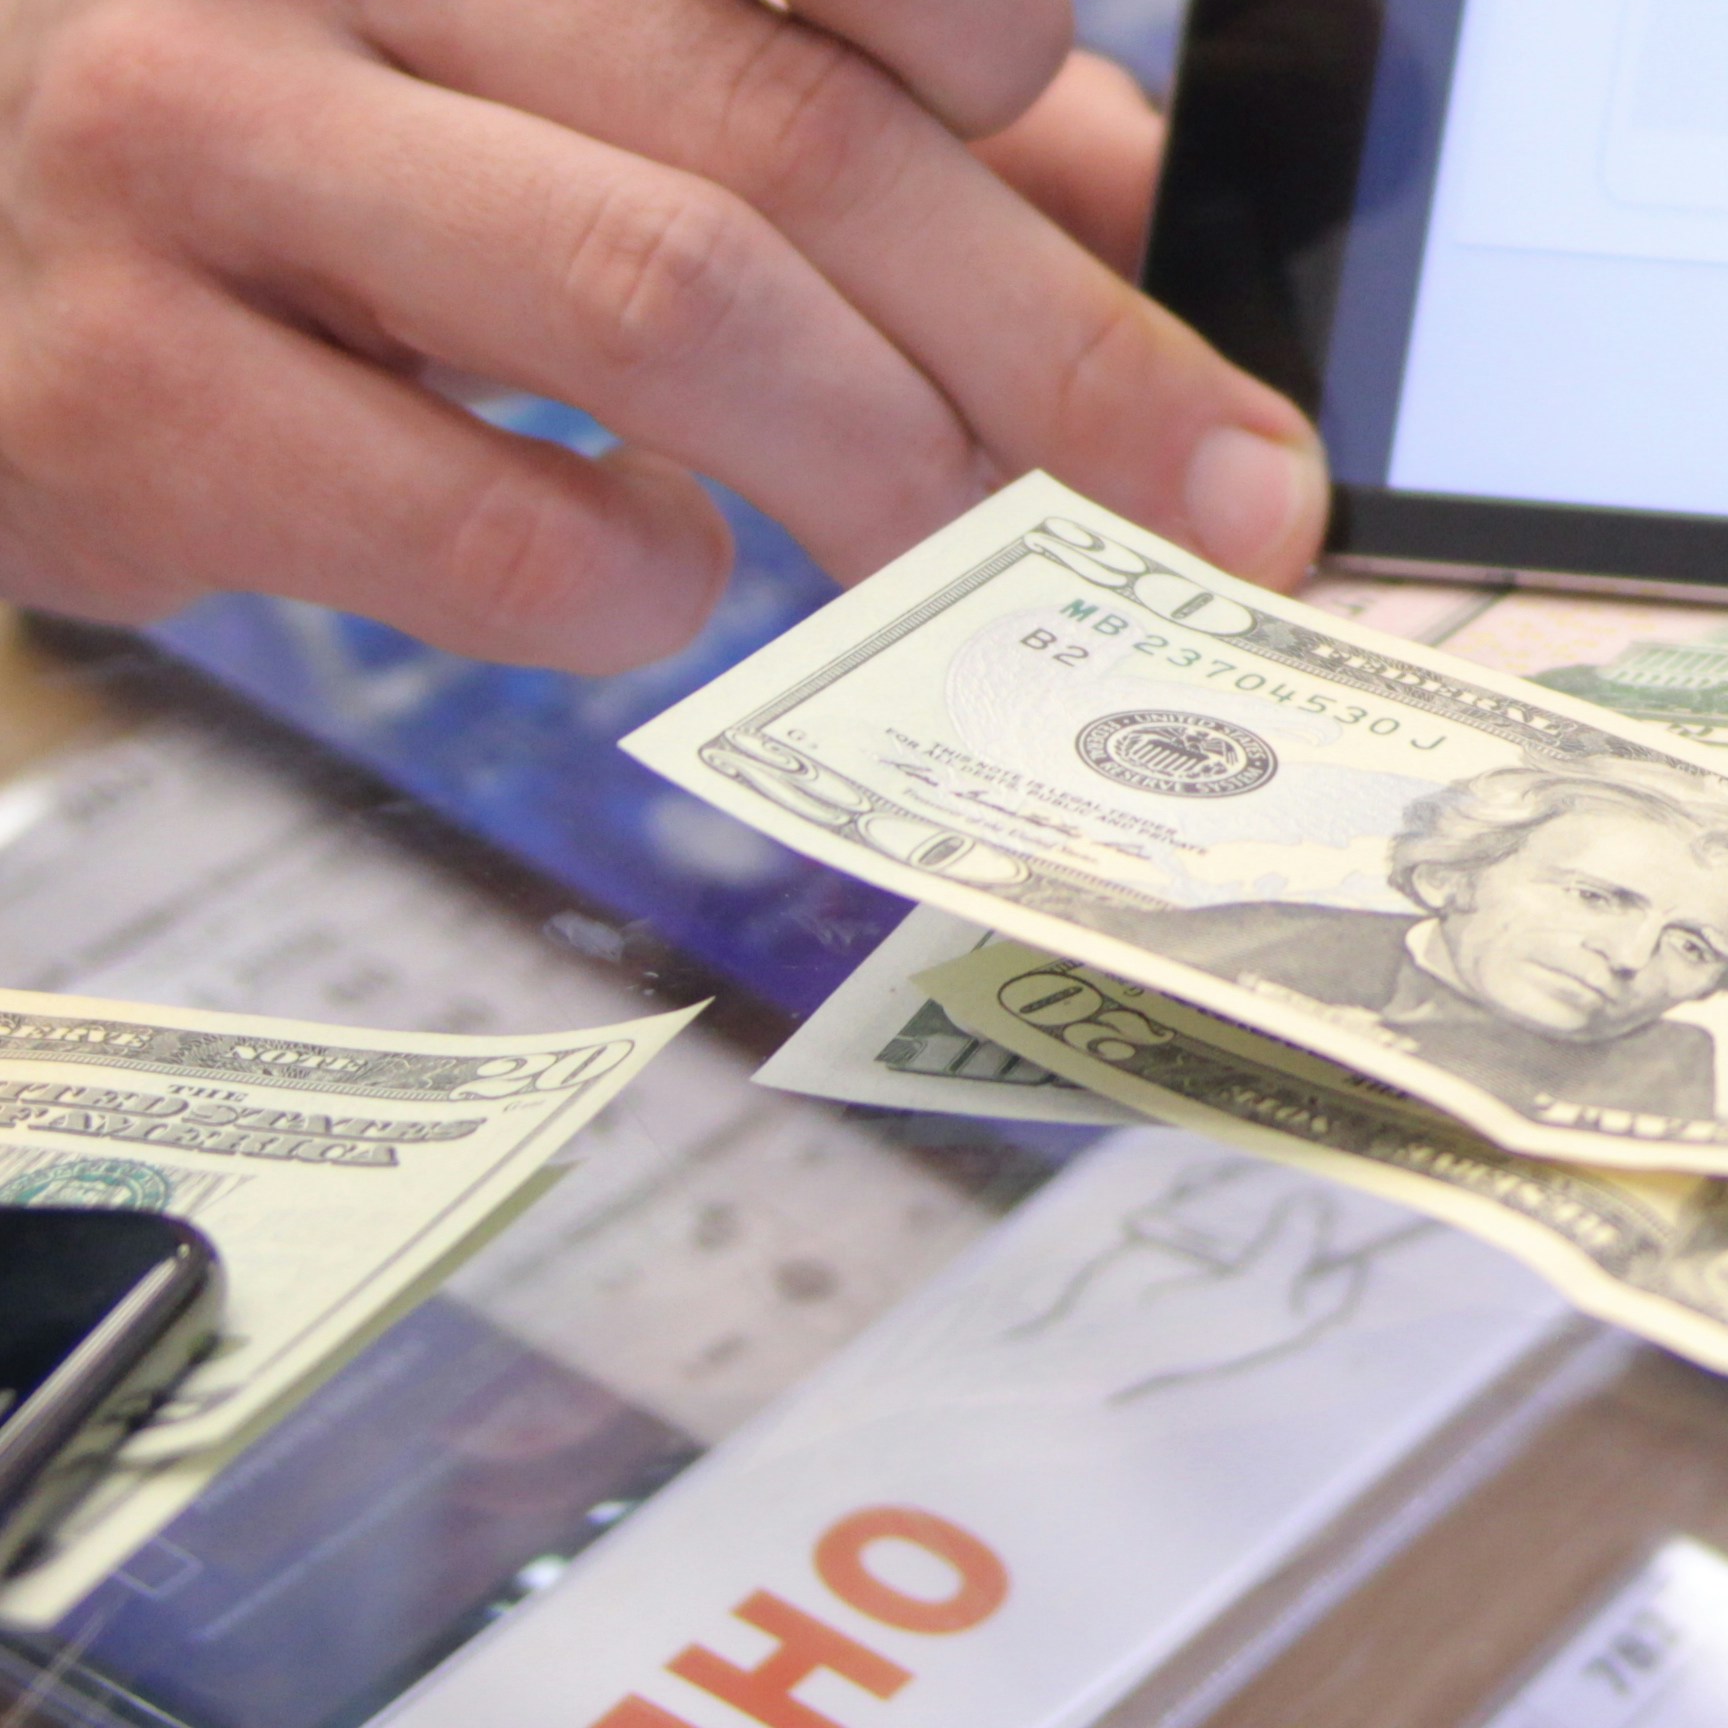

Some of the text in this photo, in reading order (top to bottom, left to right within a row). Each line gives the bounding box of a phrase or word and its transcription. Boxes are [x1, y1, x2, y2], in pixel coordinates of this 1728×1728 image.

[1018, 628, 1091, 669] B2
[884, 726, 922, 750] FOR
[226, 1043, 371, 1073] NOTE
[449, 1038, 636, 1101] 20
[167, 1083, 249, 1103] THE
[27, 1110, 400, 1168] AMERICA
